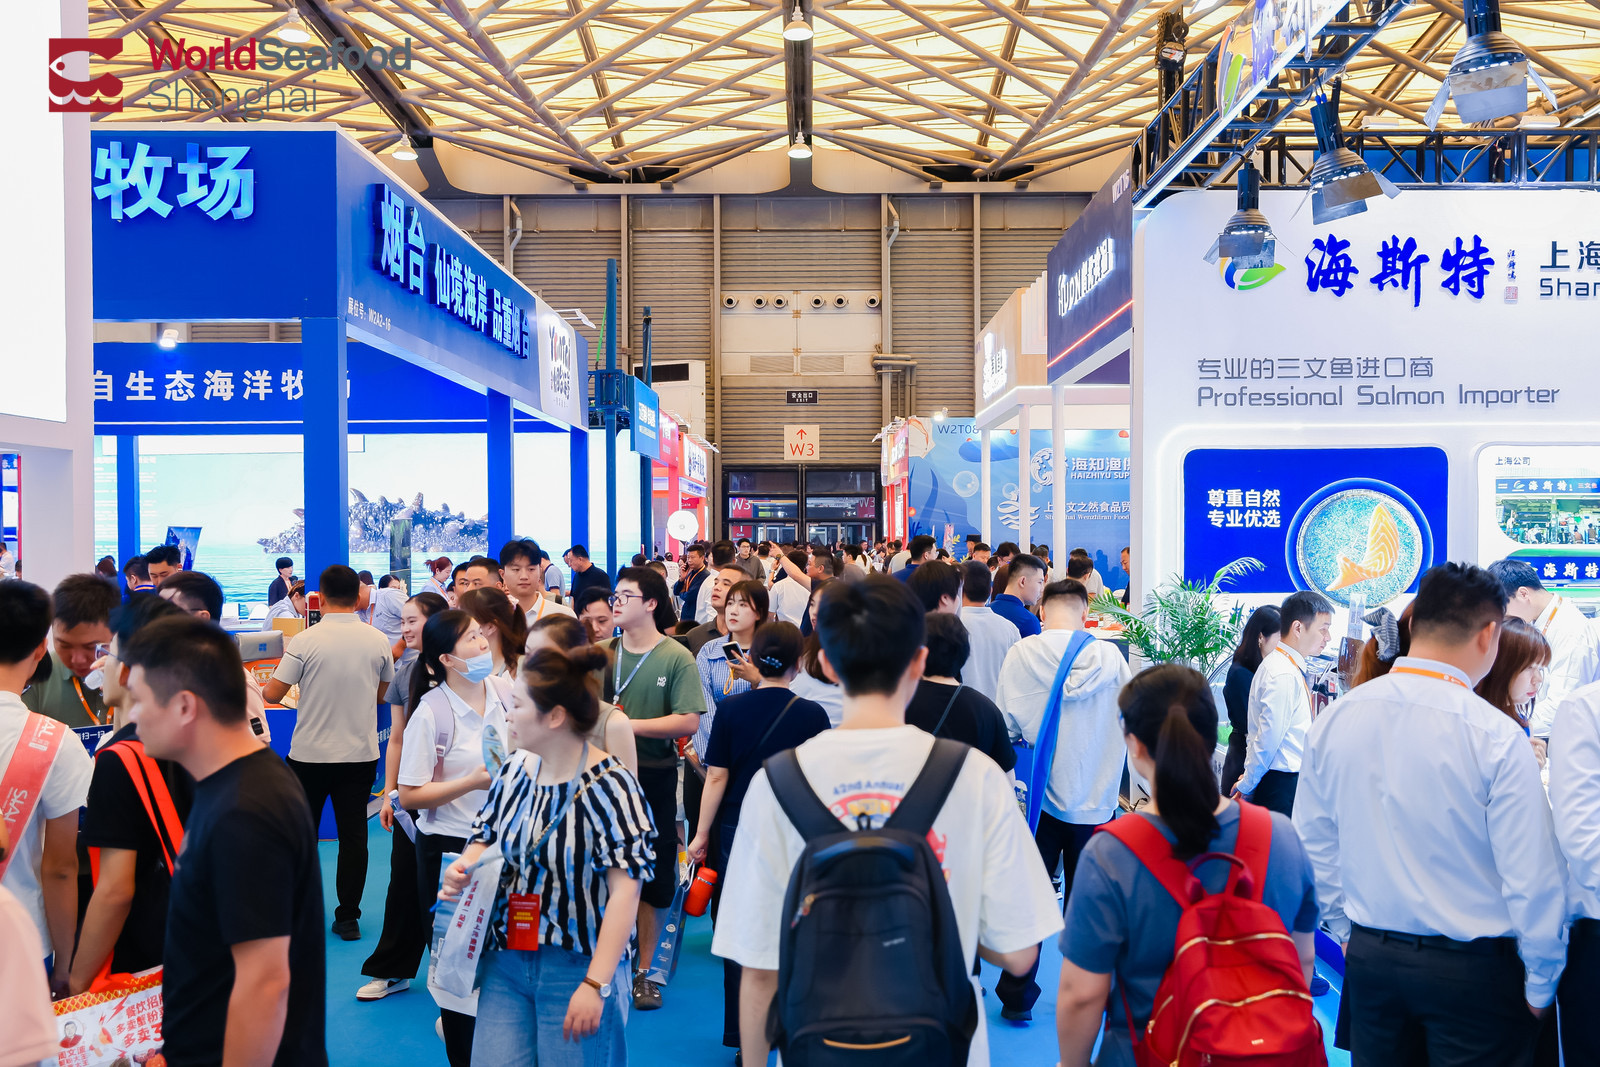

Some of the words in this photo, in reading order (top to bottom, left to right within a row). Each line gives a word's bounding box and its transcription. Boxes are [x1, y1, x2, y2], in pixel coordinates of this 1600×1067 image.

[93, 140, 254, 221] 牧场
[378, 184, 426, 296] 烟台
[432, 243, 488, 333] 仙境海岸
[491, 288, 530, 360] 品重烟台
[1304, 233, 1495, 307] 海斯特
[1197, 356, 1434, 379] 专业的三文鱼进口商
[1197, 384, 1344, 407] Professional
[1356, 384, 1446, 406] Salmon
[1458, 383, 1561, 408] Importer
[789, 443, 815, 456] W3
[1495, 456, 1531, 466] 上海公司
[732, 498, 751, 510] W3
[1043, 501, 1130, 513] 上文之然食品贸
[1207, 489, 1281, 508] 尊重自然
[1207, 509, 1281, 528] 专业优选
[1543, 562, 1600, 581] 海斯特
